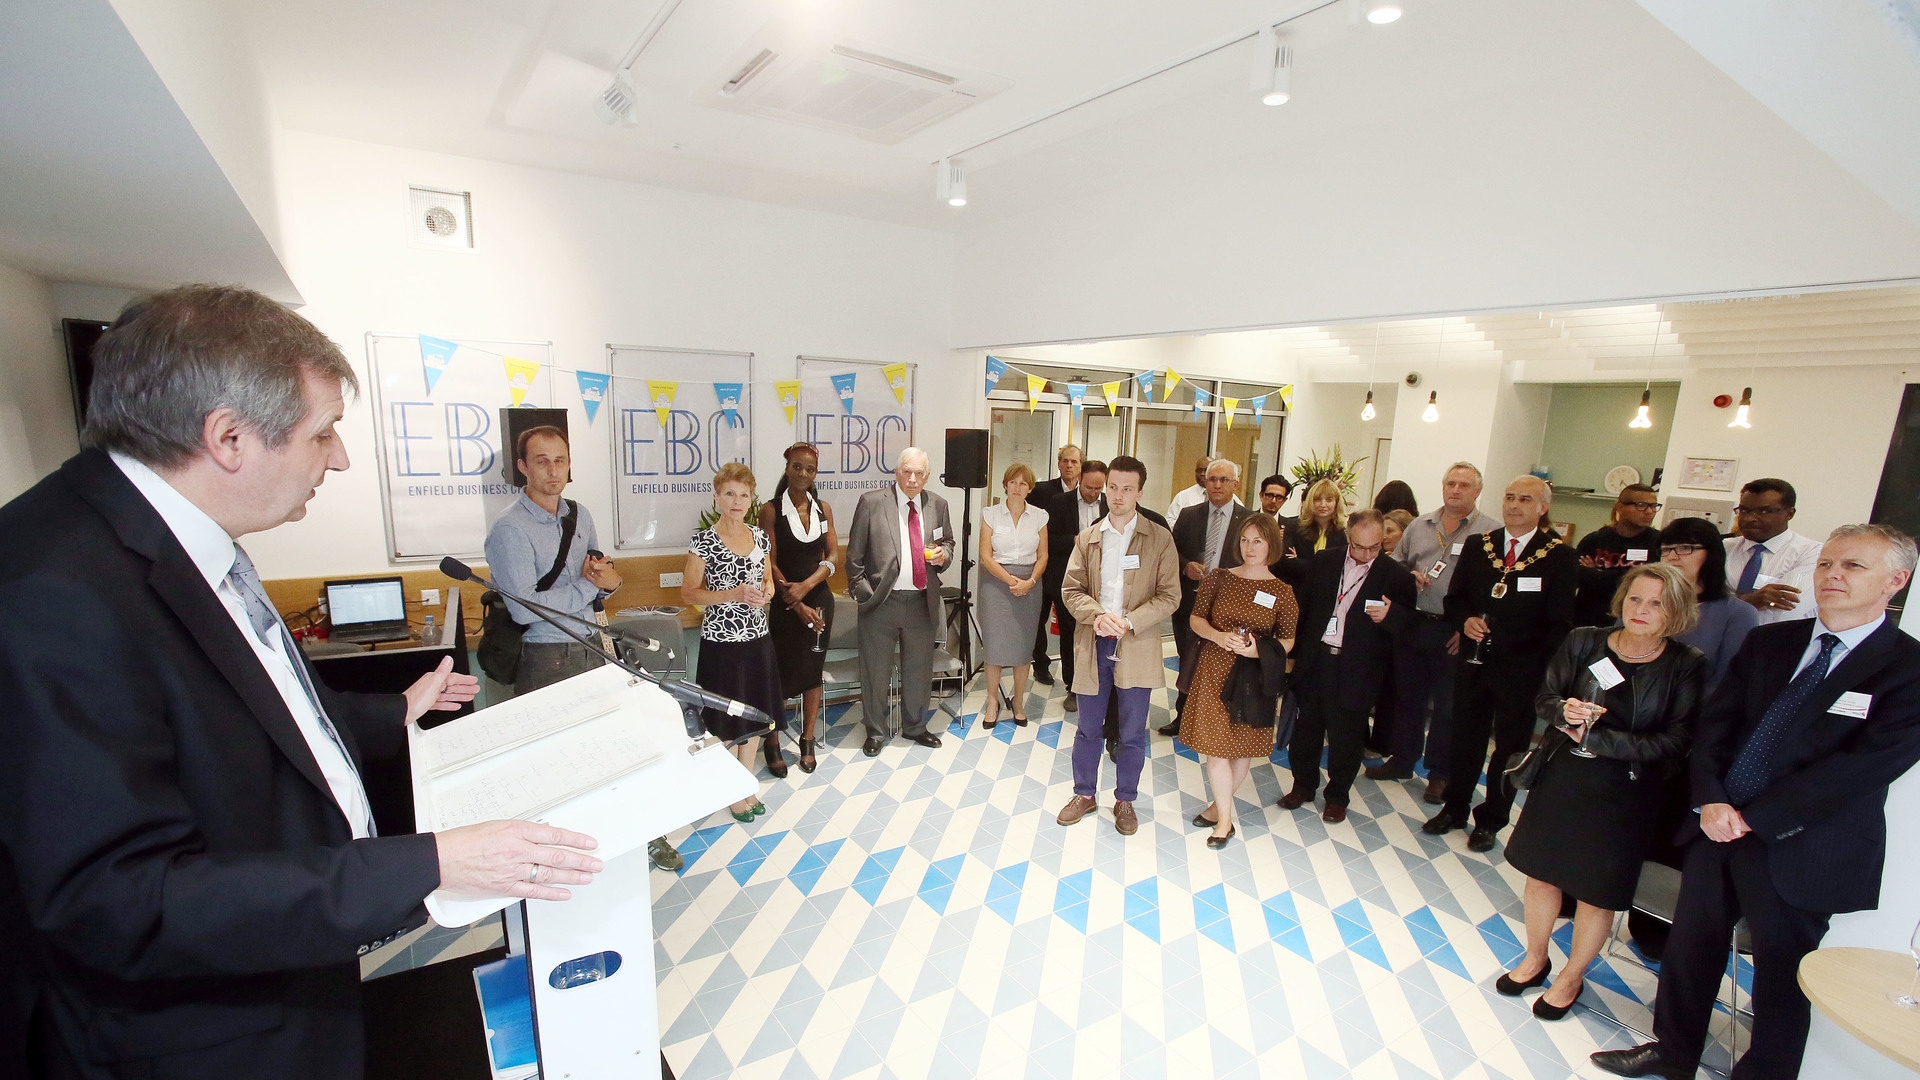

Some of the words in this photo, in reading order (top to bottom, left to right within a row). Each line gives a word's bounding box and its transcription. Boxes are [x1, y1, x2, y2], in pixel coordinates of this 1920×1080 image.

[621, 409, 745, 476] EBC
[806, 413, 907, 475] EBC
[408, 484, 454, 496] ENFIELD
[457, 484, 508, 496] BUSINESS
[632, 483, 669, 494] ENFIELD
[671, 482, 712, 493] BUSINESS
[844, 480, 878, 490] BUSINESS
